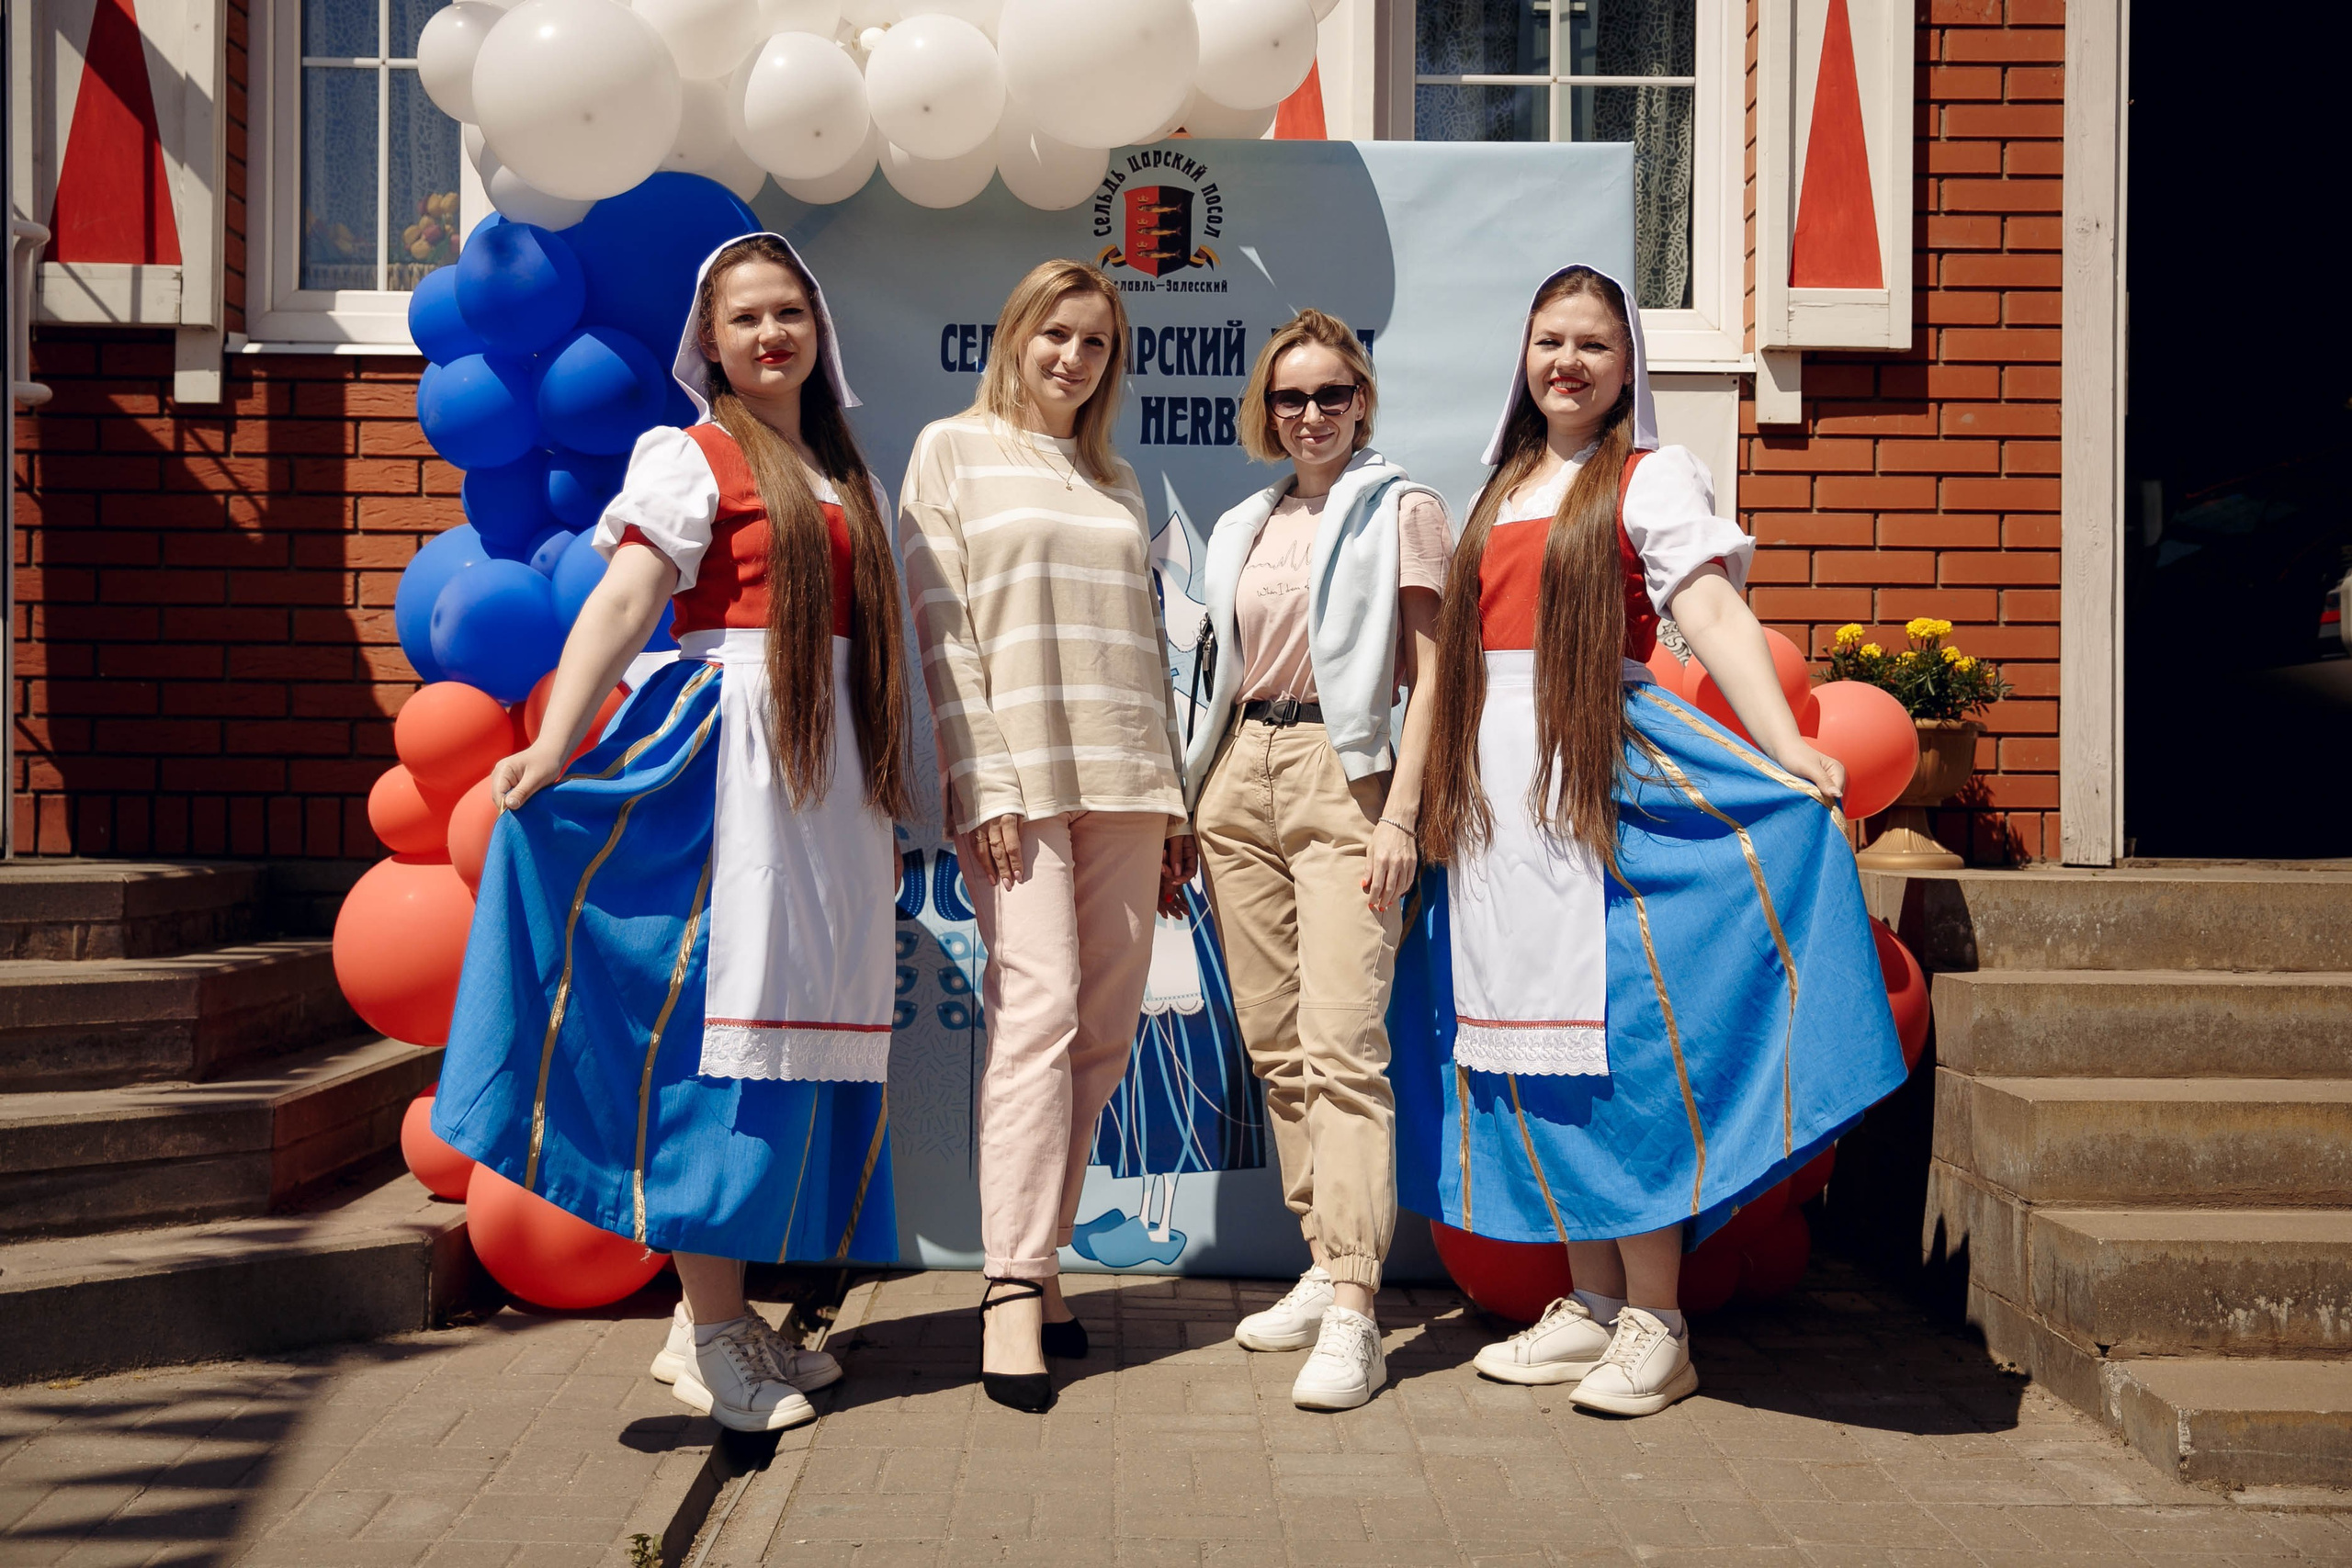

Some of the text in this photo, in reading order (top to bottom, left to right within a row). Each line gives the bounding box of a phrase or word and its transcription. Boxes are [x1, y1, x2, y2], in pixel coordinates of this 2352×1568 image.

[940, 322, 998, 374] СЕЛ
[1125, 320, 1247, 378] РСКИЙ
[1139, 395, 1245, 446] HERB
